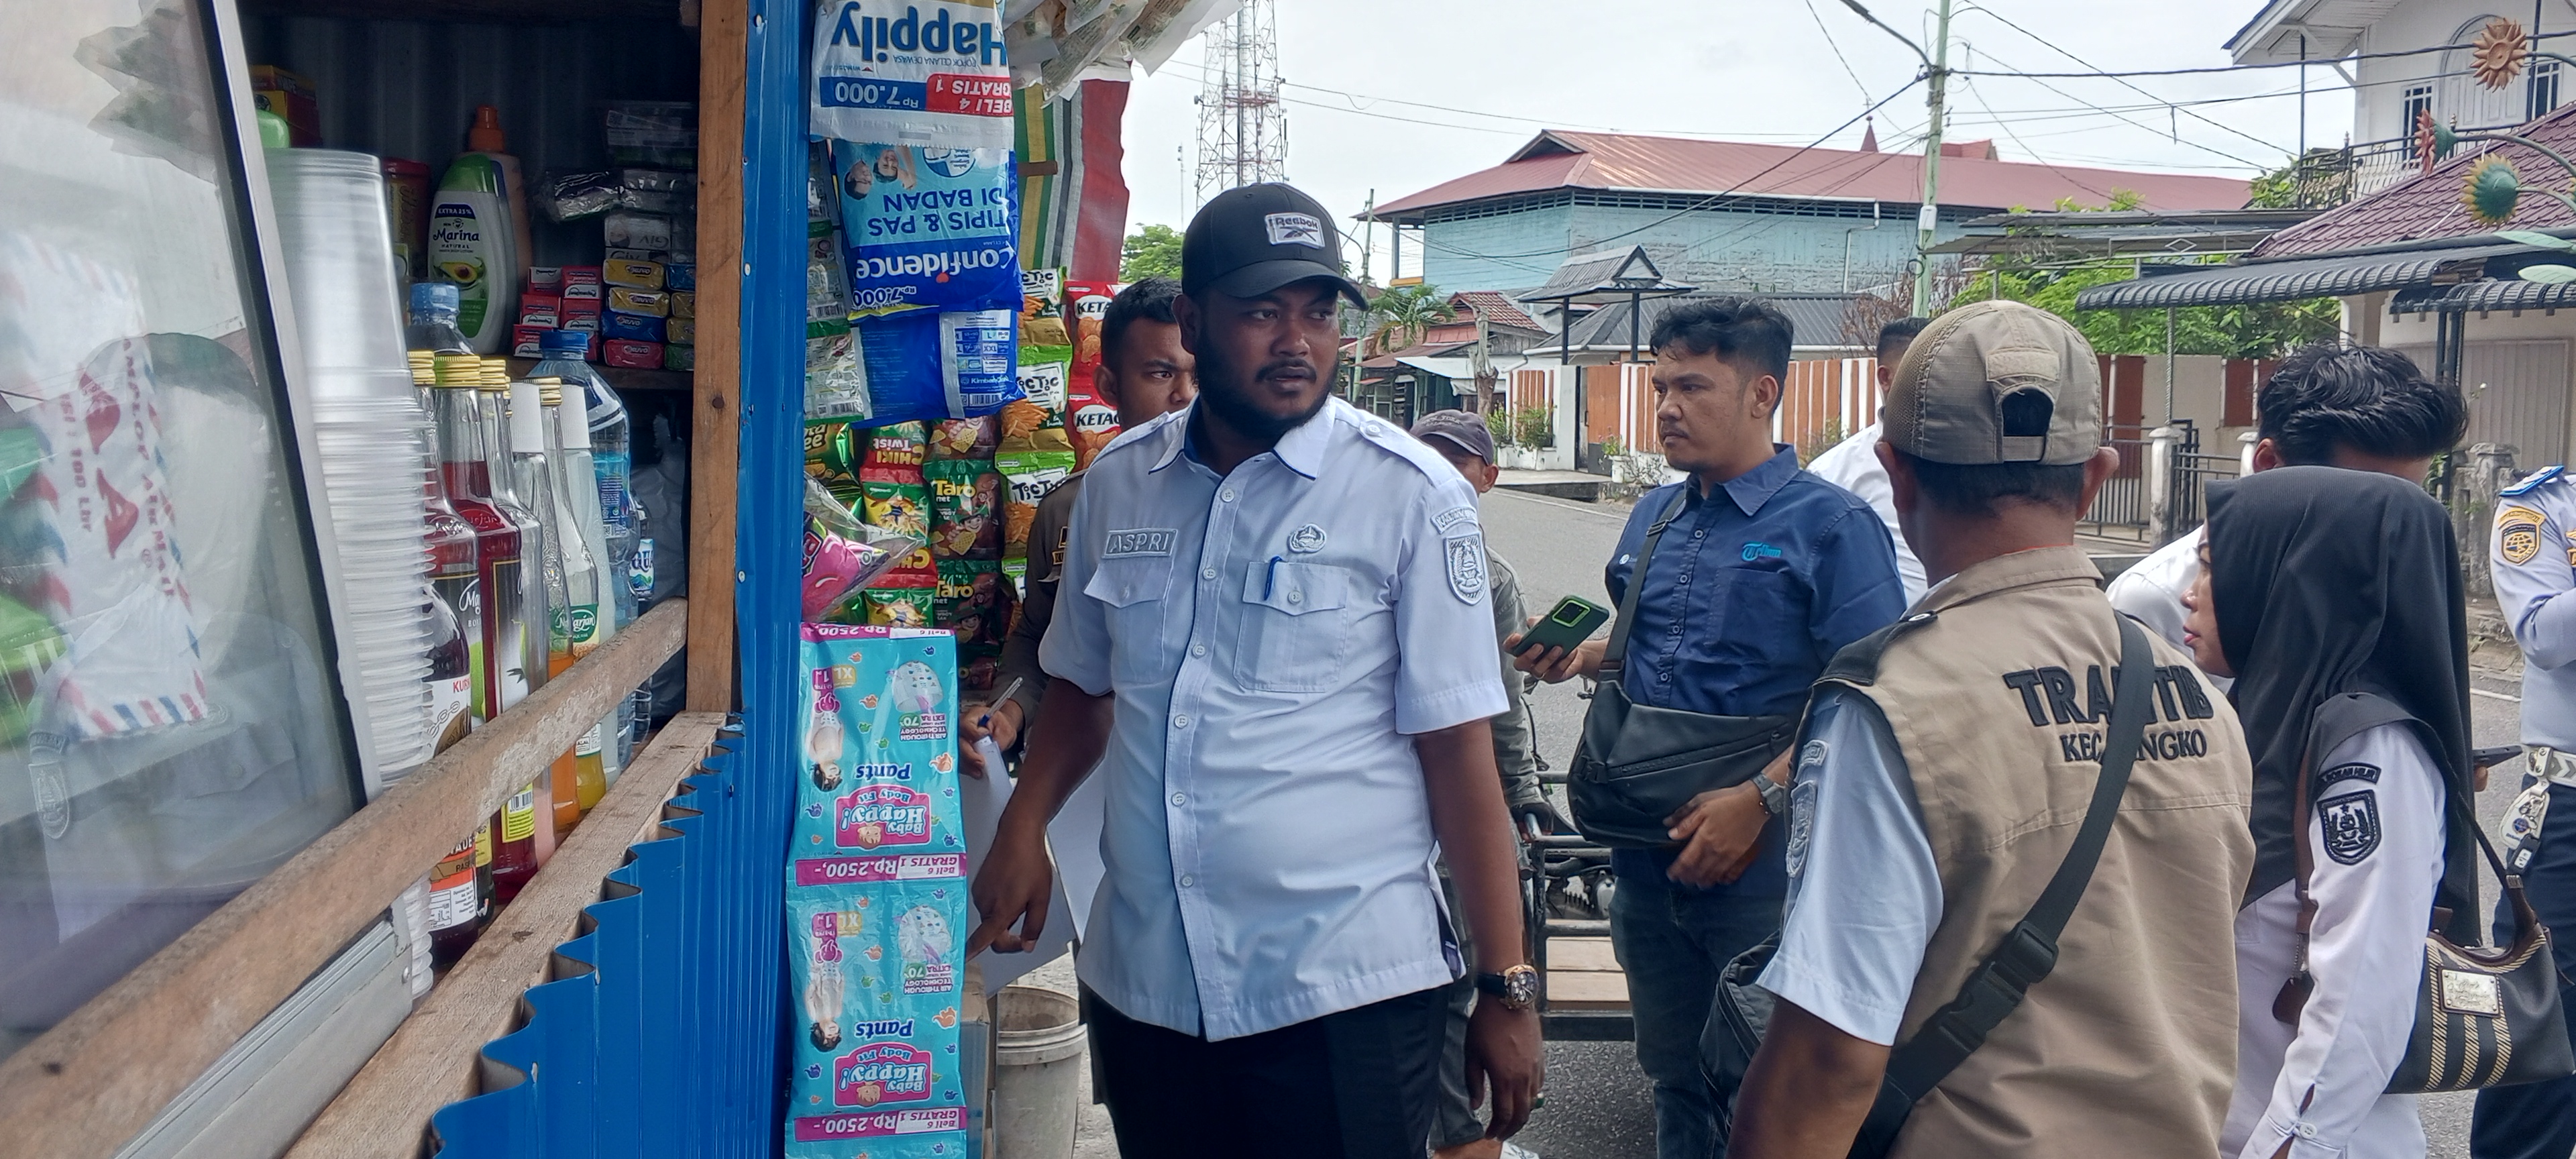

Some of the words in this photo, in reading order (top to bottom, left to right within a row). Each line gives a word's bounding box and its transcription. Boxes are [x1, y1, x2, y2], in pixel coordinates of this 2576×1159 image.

[830, 1, 1007, 66] Happily
[893, 55, 923, 64] DEWASA
[924, 58, 952, 66] CELANA
[935, 76, 944, 93] 1
[951, 80, 1012, 97] GRATIS
[835, 82, 900, 105] 7.000
[902, 97, 918, 108] Rp
[959, 97, 968, 110] 4
[975, 98, 1012, 114] BELI
[883, 189, 973, 213] BADAN
[982, 187, 1002, 206] DI
[867, 215, 916, 237] PAS
[923, 213, 940, 232] &
[948, 209, 1006, 230] TIPIS
[1275, 217, 1318, 229] Reebok
[433, 228, 480, 243] Marina
[856, 243, 1015, 280] Confidence
[873, 437, 912, 451] Twist
[876, 444, 925, 466] CHIKI
[934, 480, 977, 497] Taro
[1109, 533, 1169, 553] ASPRI
[934, 580, 974, 598] Taro
[822, 669, 829, 681] 1
[834, 667, 854, 679] XL
[899, 726, 947, 734] TECHNOLOGY
[855, 763, 912, 780] Pants
[857, 791, 877, 804] Fit
[880, 789, 910, 804] Body
[841, 805, 926, 832] Happy!
[886, 823, 924, 836] Baby
[900, 859, 907, 867] 1
[911, 858, 958, 867] GRATIS
[824, 916, 833, 928] 1
[839, 914, 859, 927] XL
[904, 979, 953, 987] TECHNOLOGY
[855, 1019, 913, 1039] Pants
[857, 1050, 877, 1062] Fit
[879, 1047, 912, 1062] Body
[840, 1062, 927, 1090] Happy!
[885, 1080, 924, 1093] Baby
[900, 1112, 906, 1121] 1
[910, 1110, 957, 1119] GRATIS
[926, 1120, 933, 1128] 6
